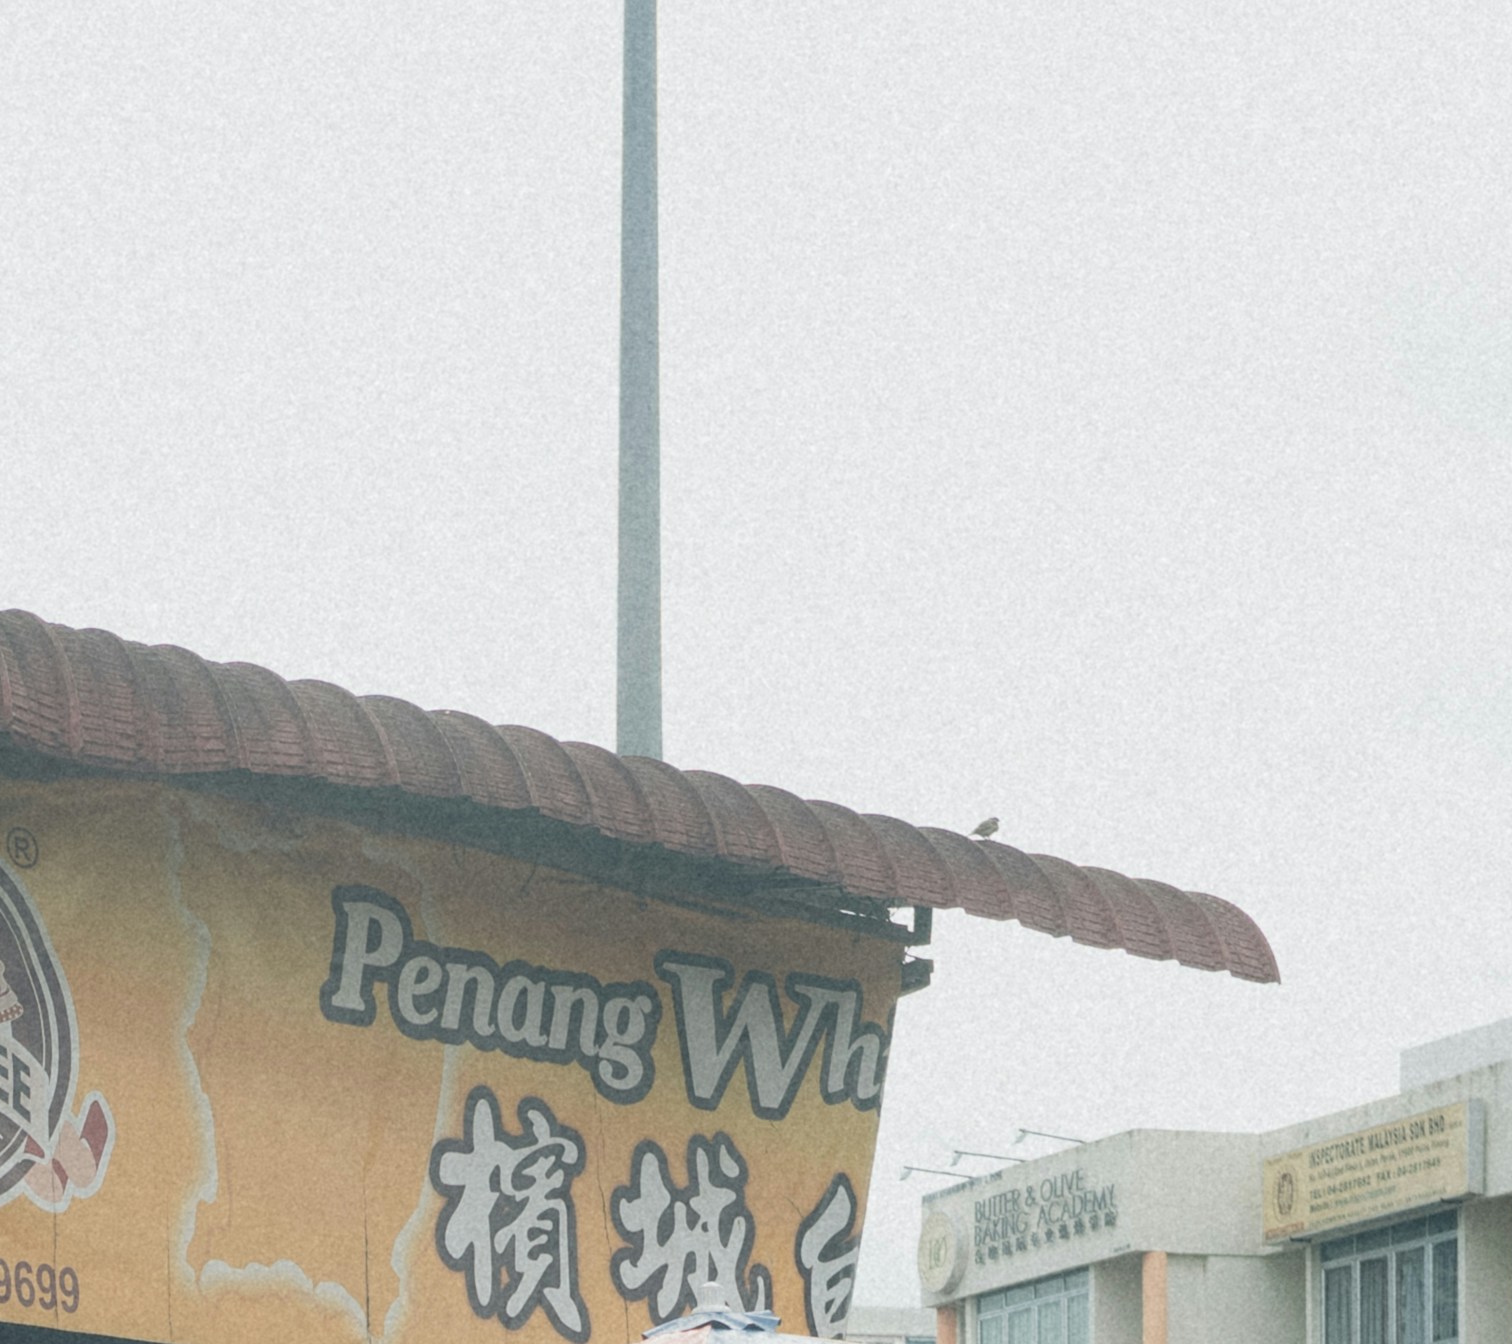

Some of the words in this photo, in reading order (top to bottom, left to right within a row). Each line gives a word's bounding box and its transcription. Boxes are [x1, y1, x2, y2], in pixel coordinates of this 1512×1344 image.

[328, 898, 656, 1093] Penang
[660, 958, 889, 1110] Wh
[974, 1188, 1021, 1224] BUTTER
[1025, 1185, 1037, 1208] &
[1039, 1168, 1086, 1203] OLIVE
[974, 1211, 1029, 1248] BAKING
[1037, 1184, 1118, 1229] ACADEMY
